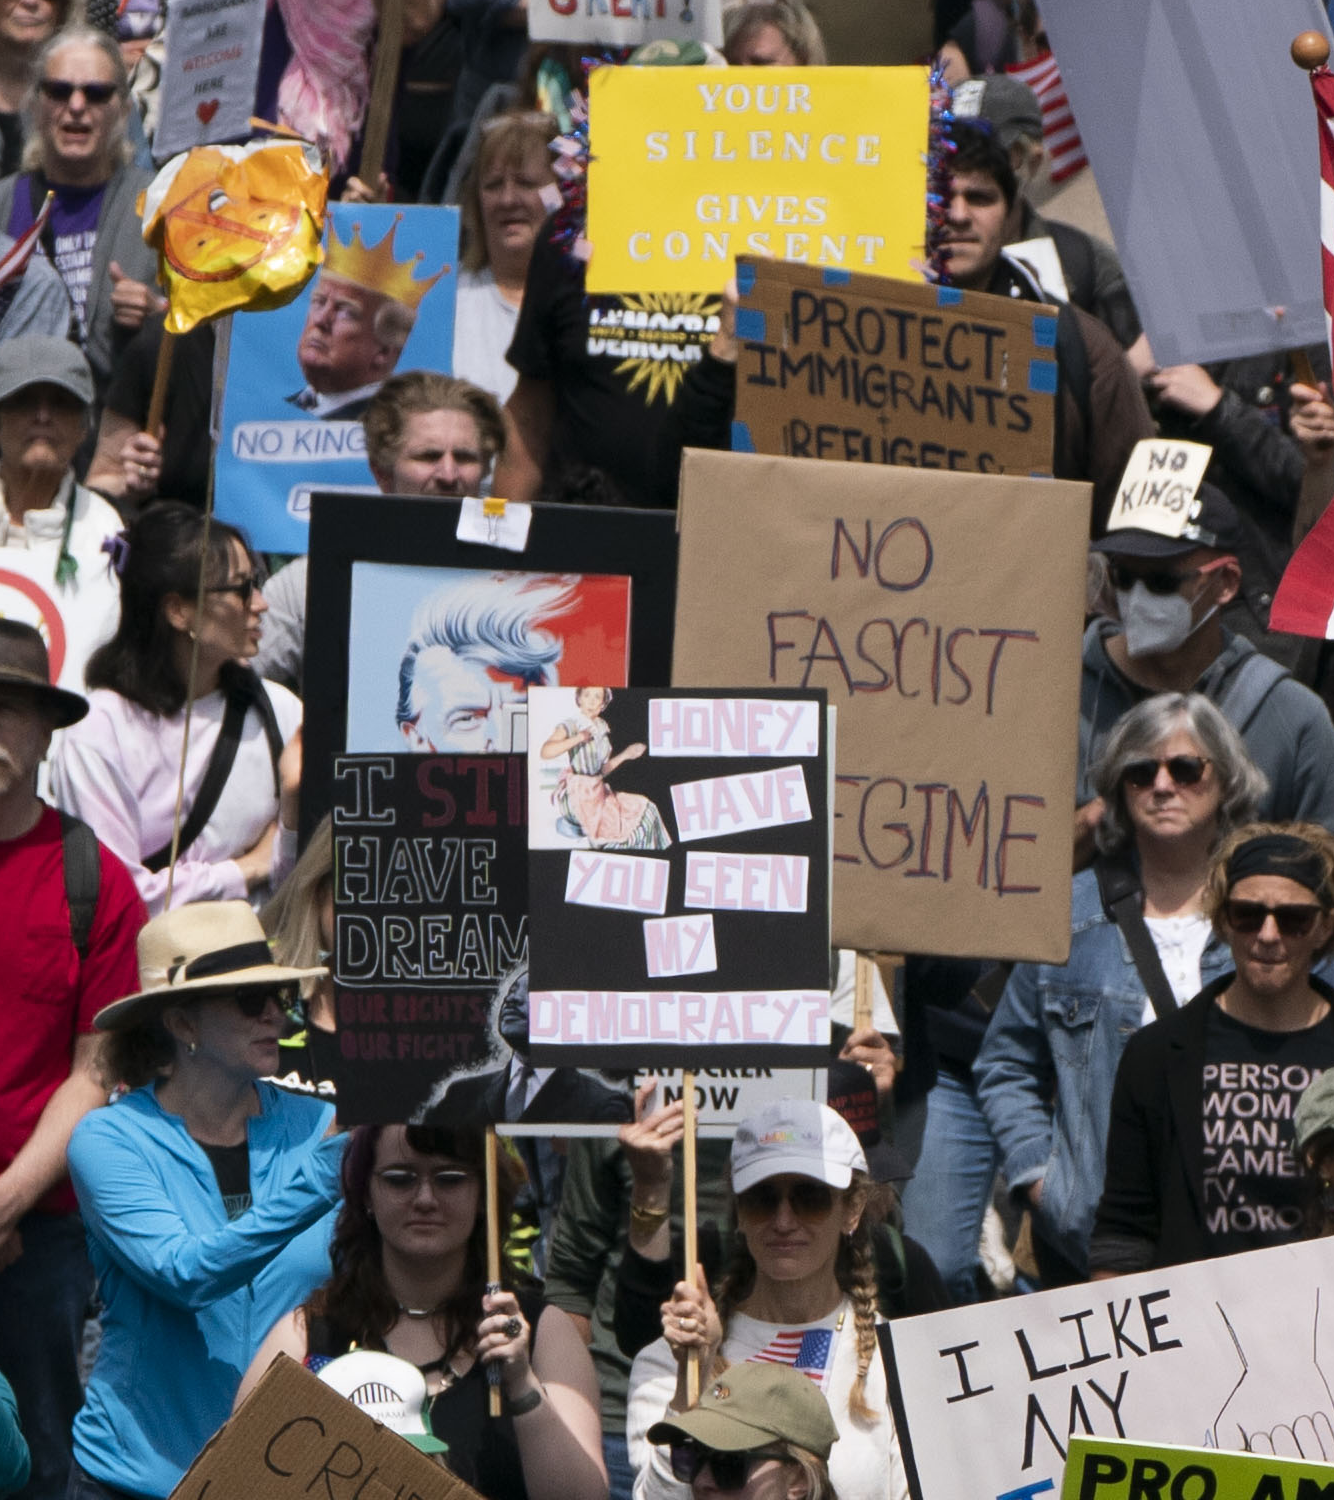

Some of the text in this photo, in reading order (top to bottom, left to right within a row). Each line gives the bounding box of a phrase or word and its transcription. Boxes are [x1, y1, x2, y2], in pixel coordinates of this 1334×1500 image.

[697, 83, 814, 115] YOUR
[645, 130, 883, 166] SILENCE
[695, 194, 829, 226] GIVES
[627, 232, 887, 265] CONSENT
[1147, 448, 1189, 473] NO
[1119, 476, 1193, 514] KINGS
[571, 854, 806, 910] YOU SEEN
[645, 917, 714, 976] MY
[529, 990, 829, 1044] DEMOCRACY?
[1201, 1119, 1288, 1148] MAN.
